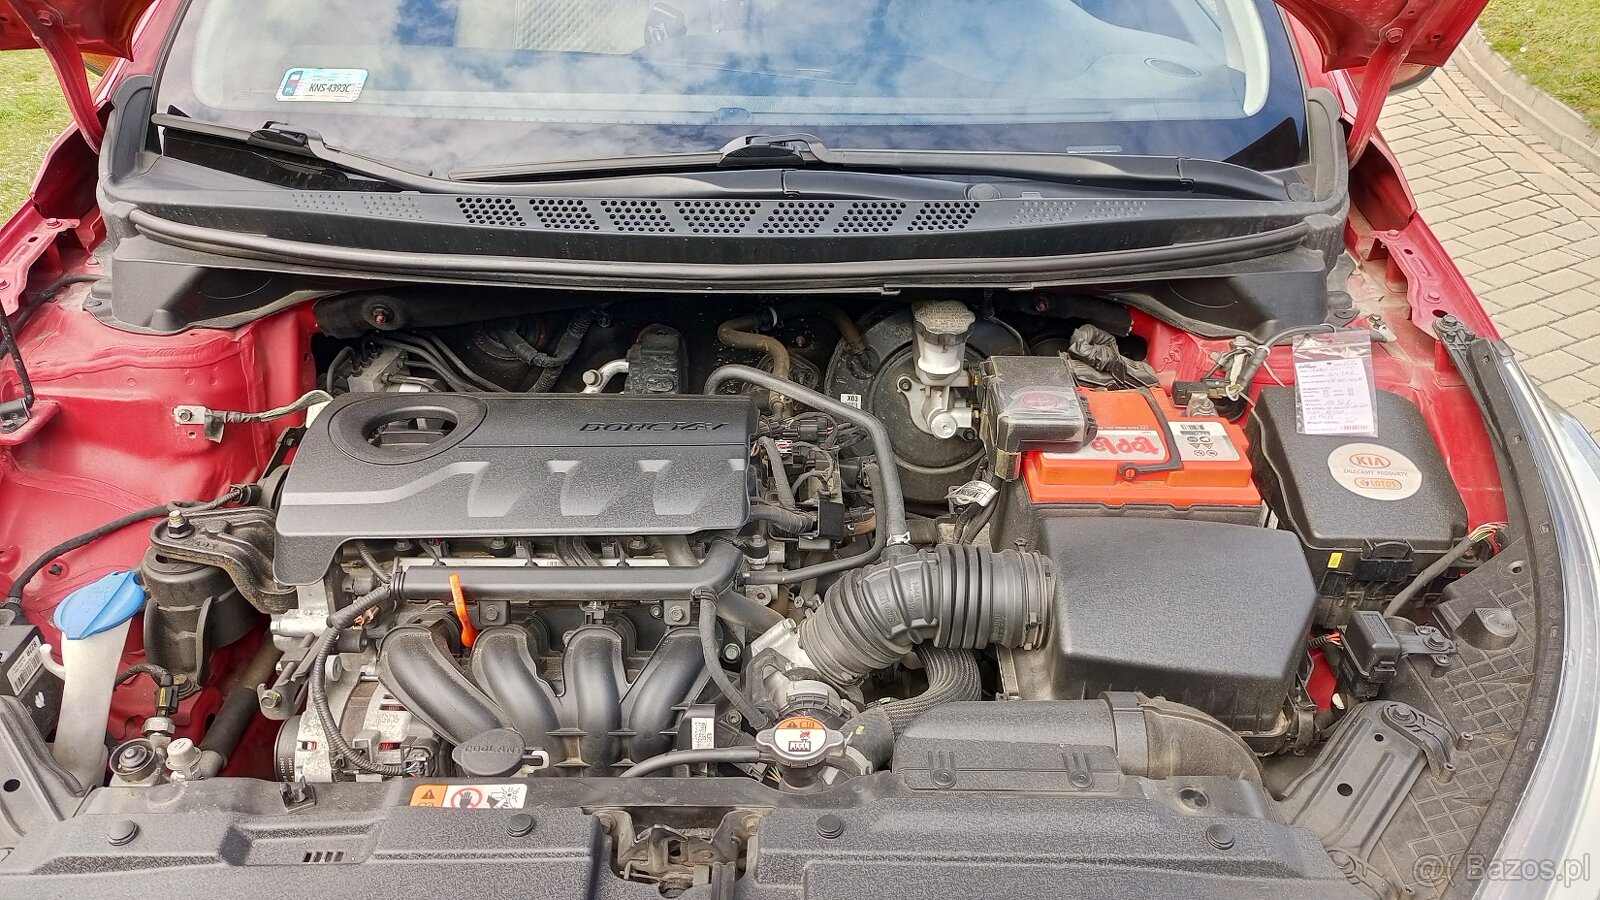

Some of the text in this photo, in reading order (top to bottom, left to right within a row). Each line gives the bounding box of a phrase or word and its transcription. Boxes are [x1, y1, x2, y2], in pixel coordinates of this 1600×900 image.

[308, 83, 352, 93] KNS 4393C
[1355, 456, 1386, 466] KIA
[1343, 468, 1375, 476] ZALECAMY
[1370, 479, 1397, 488] LOTOS
[464, 744, 522, 755] COOLANT
